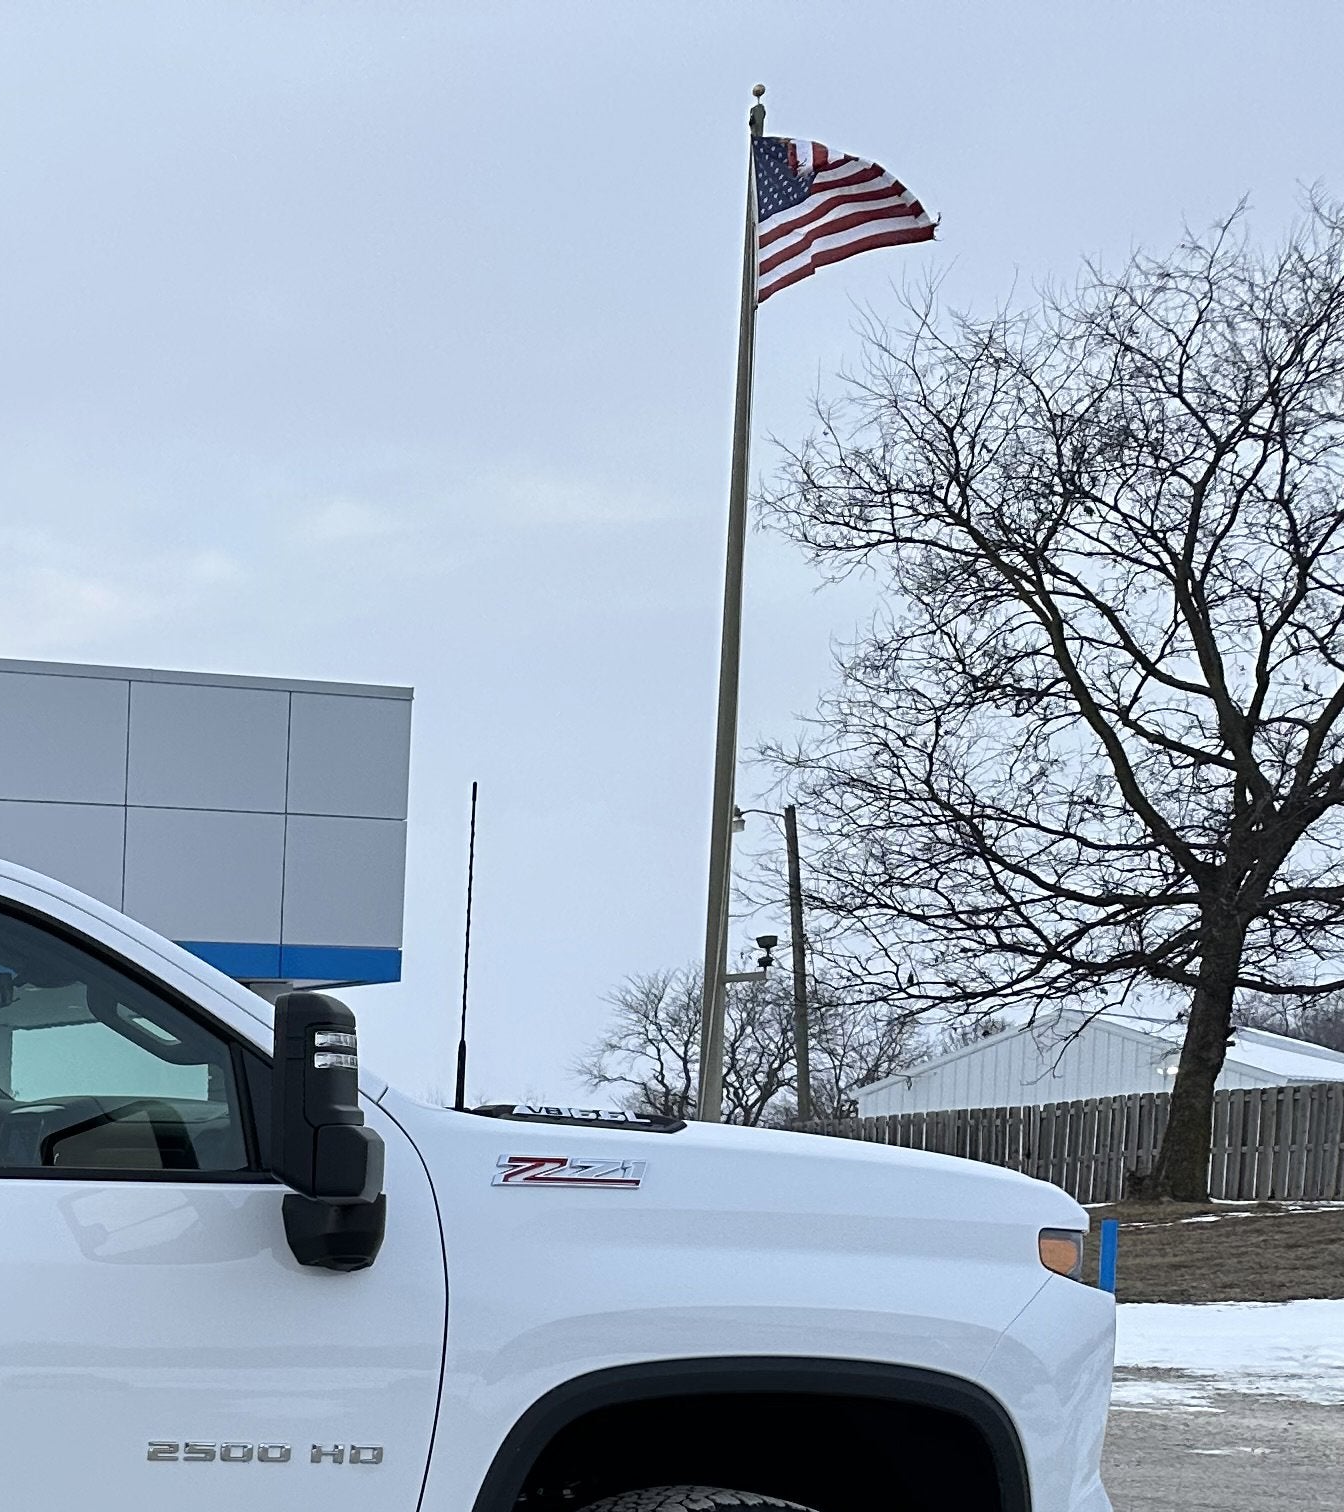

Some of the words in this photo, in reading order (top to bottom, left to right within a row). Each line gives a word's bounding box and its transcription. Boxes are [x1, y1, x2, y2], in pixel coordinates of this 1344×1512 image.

[491, 1154, 647, 1188] Z71
[147, 1440, 291, 1463] 2500
[310, 1443, 384, 1465] HD
